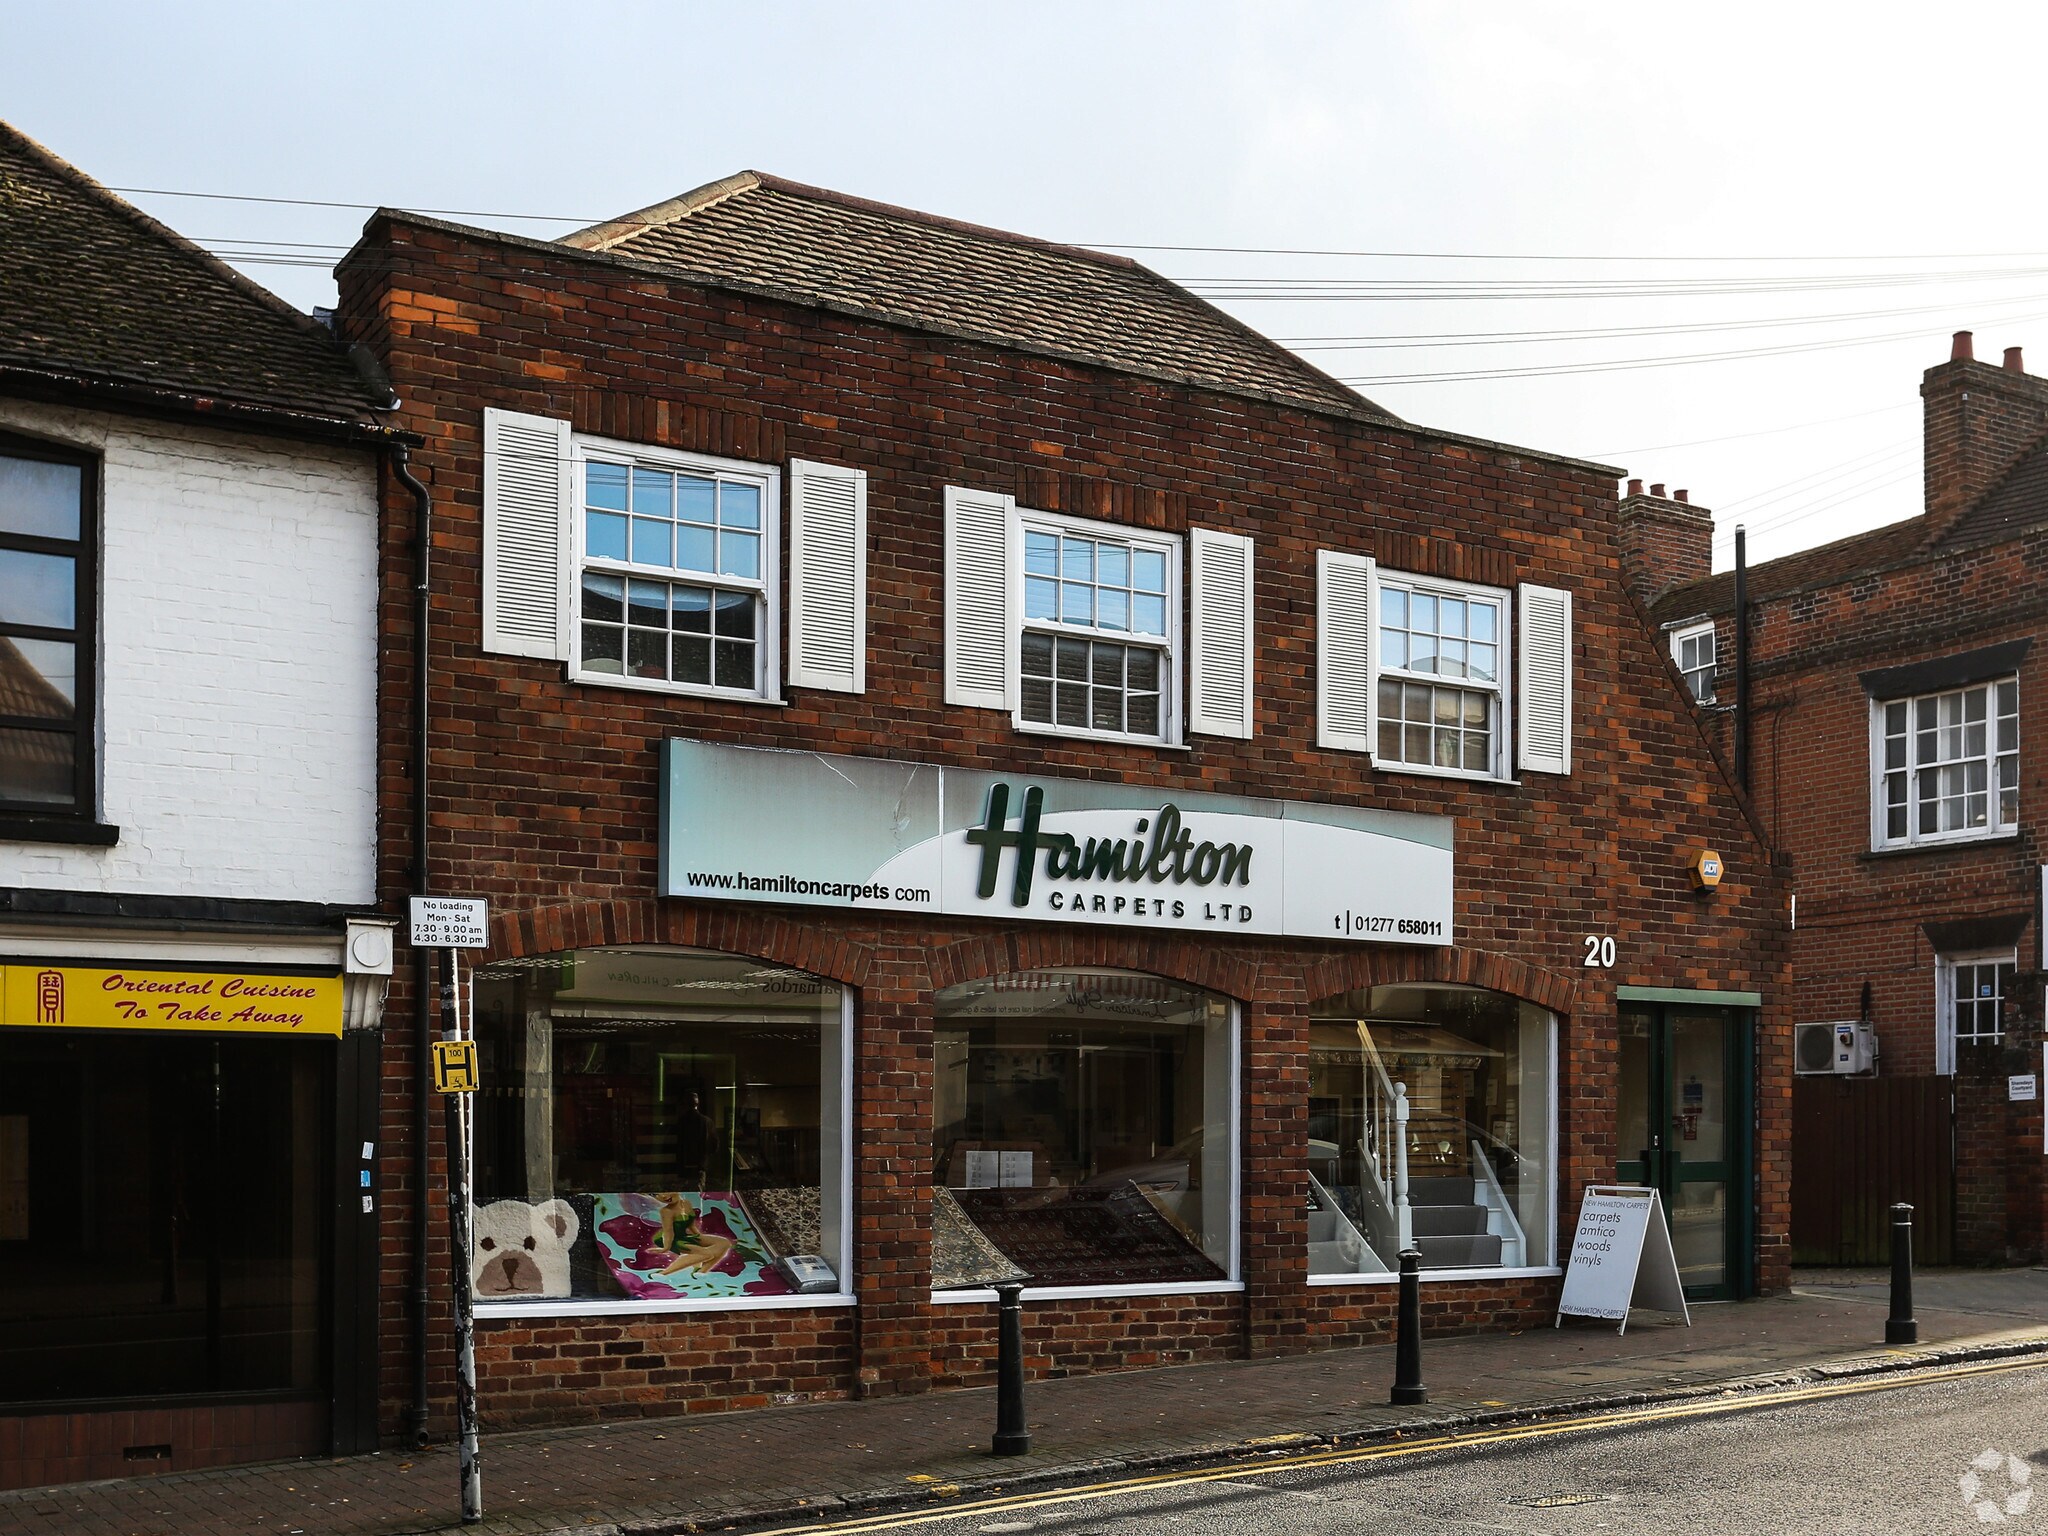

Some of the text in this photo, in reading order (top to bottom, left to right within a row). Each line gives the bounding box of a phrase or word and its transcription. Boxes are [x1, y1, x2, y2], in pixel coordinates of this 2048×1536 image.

[966, 782, 1253, 907] Hamilton
[1704, 863, 1718, 873] ADT
[423, 901, 473, 912] No loading
[1049, 891, 1253, 923] CARPETS LTD
[427, 913, 447, 921] Mon
[454, 914, 471, 922] Sat
[414, 923, 437, 932] 7.30
[444, 924, 467, 933] 9.00
[1355, 916, 1395, 932] 01277
[1398, 919, 1442, 936] 658011
[414, 934, 438, 942] 4.30
[445, 934, 467, 943] 6.30
[469, 936, 483, 944] pm
[1584, 935, 1616, 968] 20
[102, 974, 316, 998] Oriental Cuisine
[114, 1000, 304, 1027] To Take Away
[440, 1046, 472, 1087] H
[1597, 1200, 1626, 1208] HAMILTON
[1626, 1202, 1649, 1210] CARPETS
[1583, 1212, 1621, 1224] carpets
[1580, 1225, 1616, 1237] amtico
[1577, 1239, 1611, 1252] woods
[1574, 1253, 1602, 1268] vinyls
[1573, 1306, 1603, 1315] HAMILTON
[1602, 1308, 1625, 1317] CARPETS
